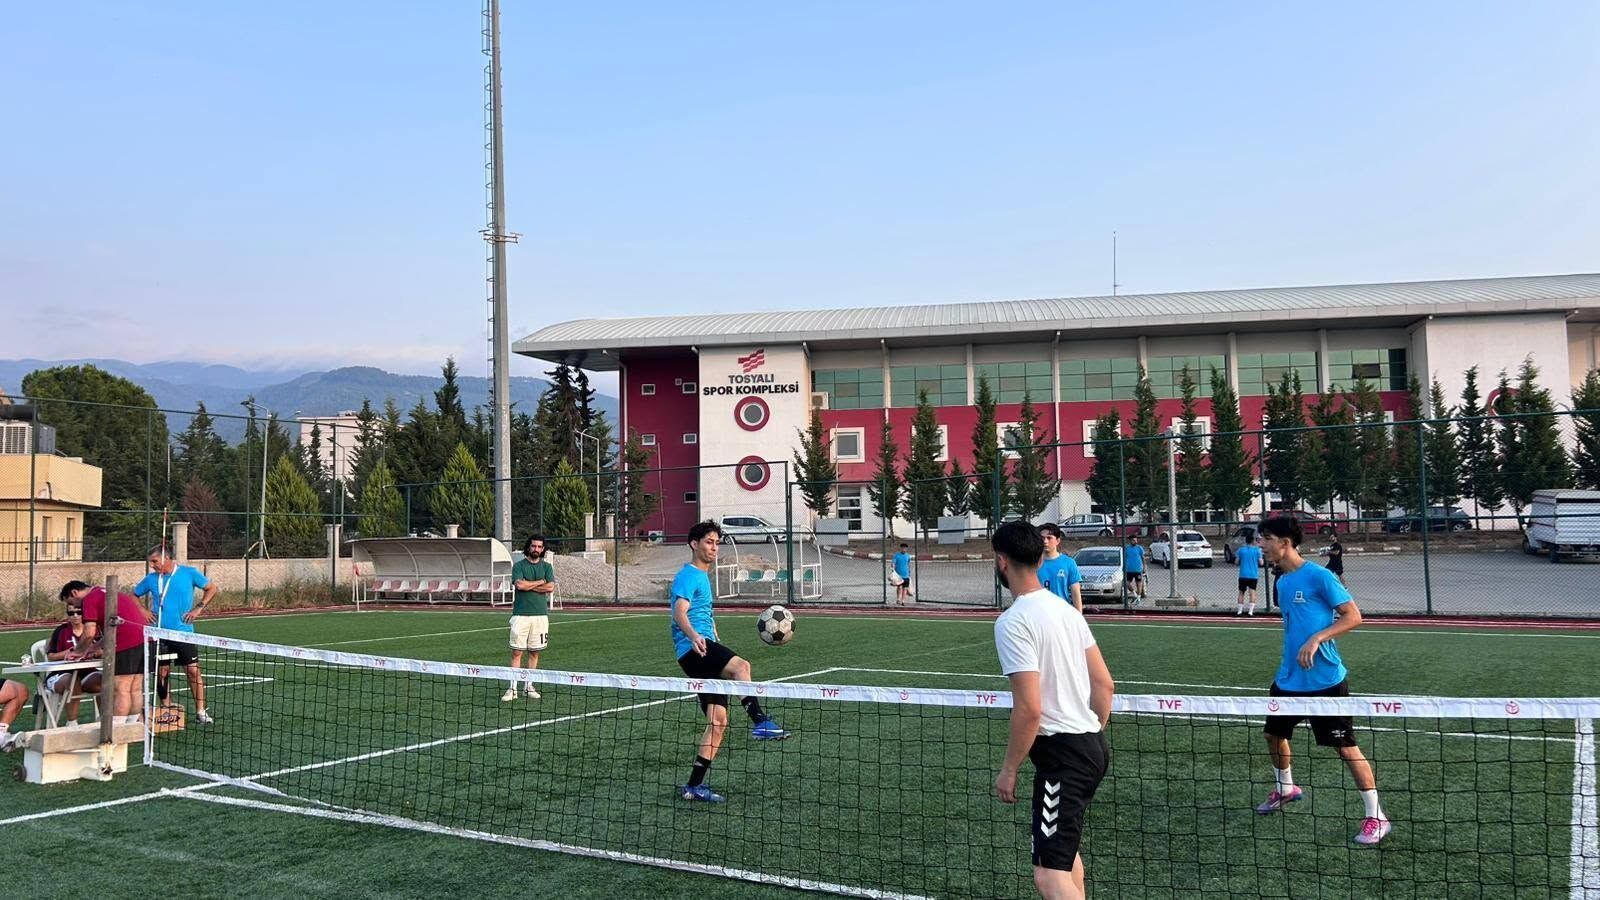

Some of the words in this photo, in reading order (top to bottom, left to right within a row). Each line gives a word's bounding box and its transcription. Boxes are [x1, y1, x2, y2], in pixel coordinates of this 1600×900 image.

[728, 374, 774, 384] TOSYALI
[703, 386, 733, 395] SPOR
[736, 381, 799, 395] KOMPLEKSİ
[466, 667, 481, 675] TVF
[570, 675, 585, 684] TVF
[686, 681, 703, 691] TVF
[821, 689, 839, 698] TVF
[976, 695, 997, 704] TVF
[1158, 699, 1182, 710] TVF
[1372, 702, 1404, 714] TVF
